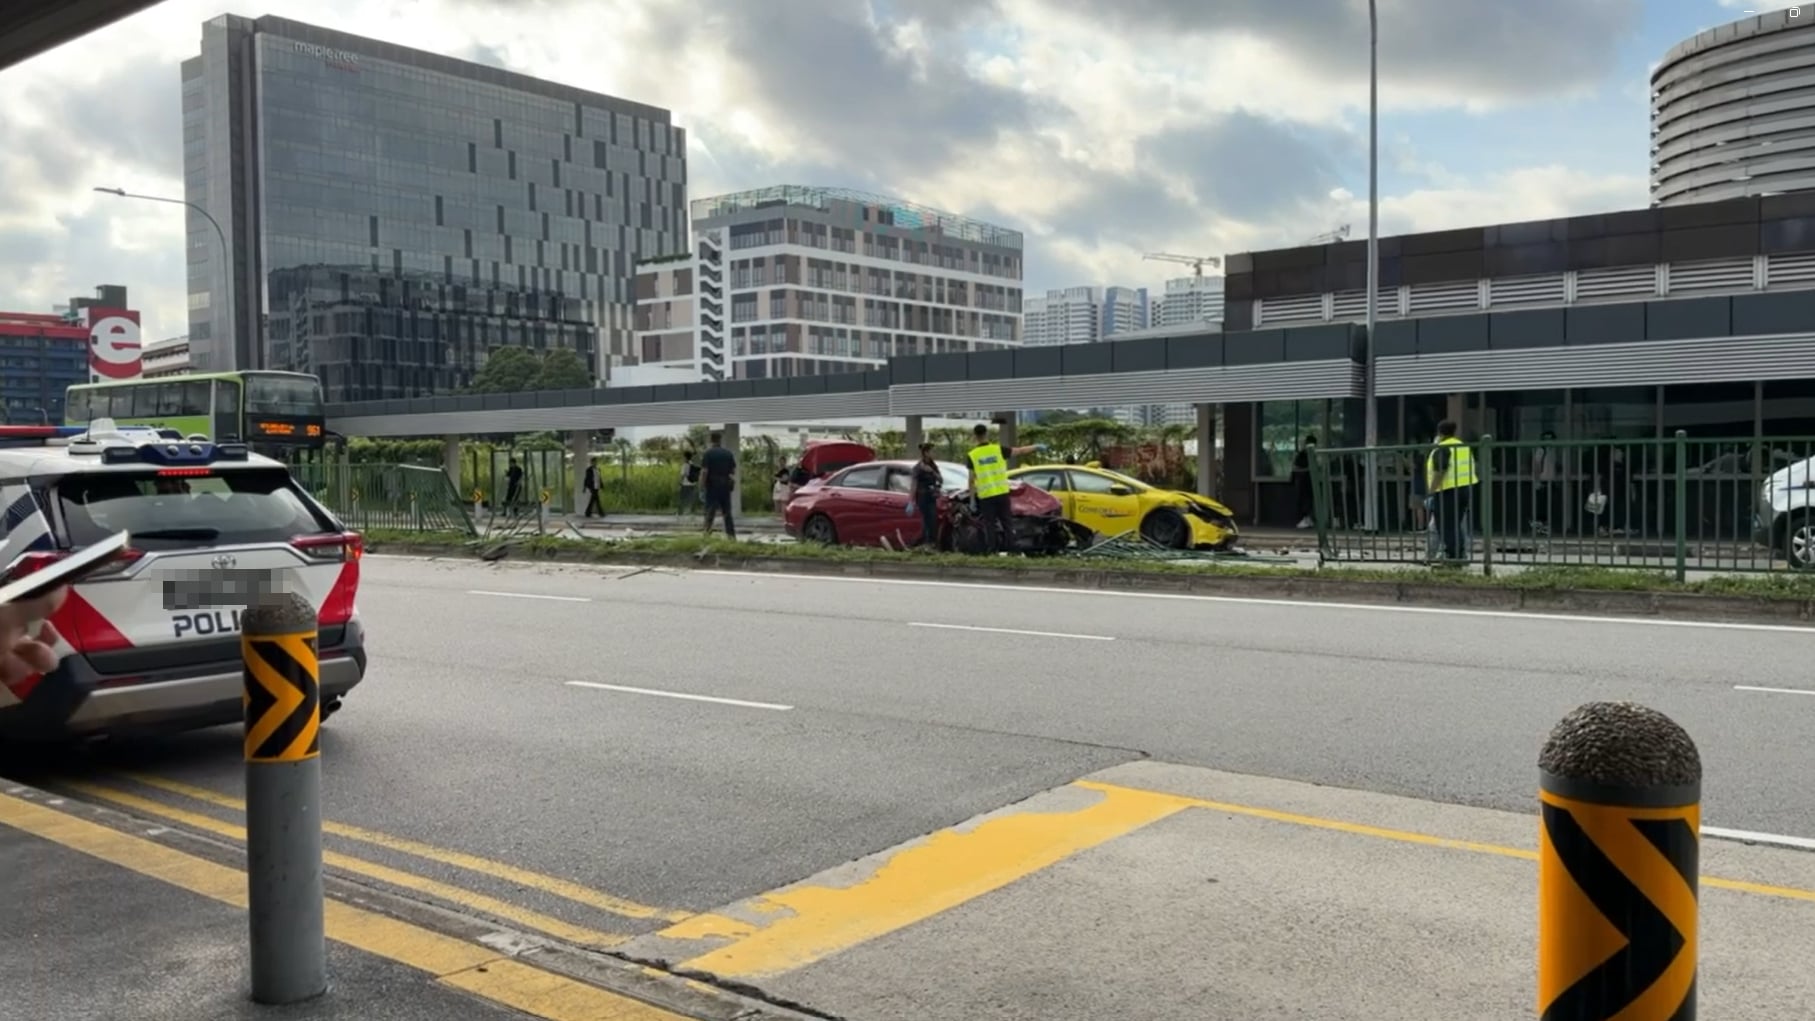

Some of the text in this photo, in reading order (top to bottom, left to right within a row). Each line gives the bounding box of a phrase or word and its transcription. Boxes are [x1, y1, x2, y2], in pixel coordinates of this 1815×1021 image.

[294, 41, 359, 64] mapletree
[91, 316, 142, 364] e
[172, 609, 241, 638] POLI
